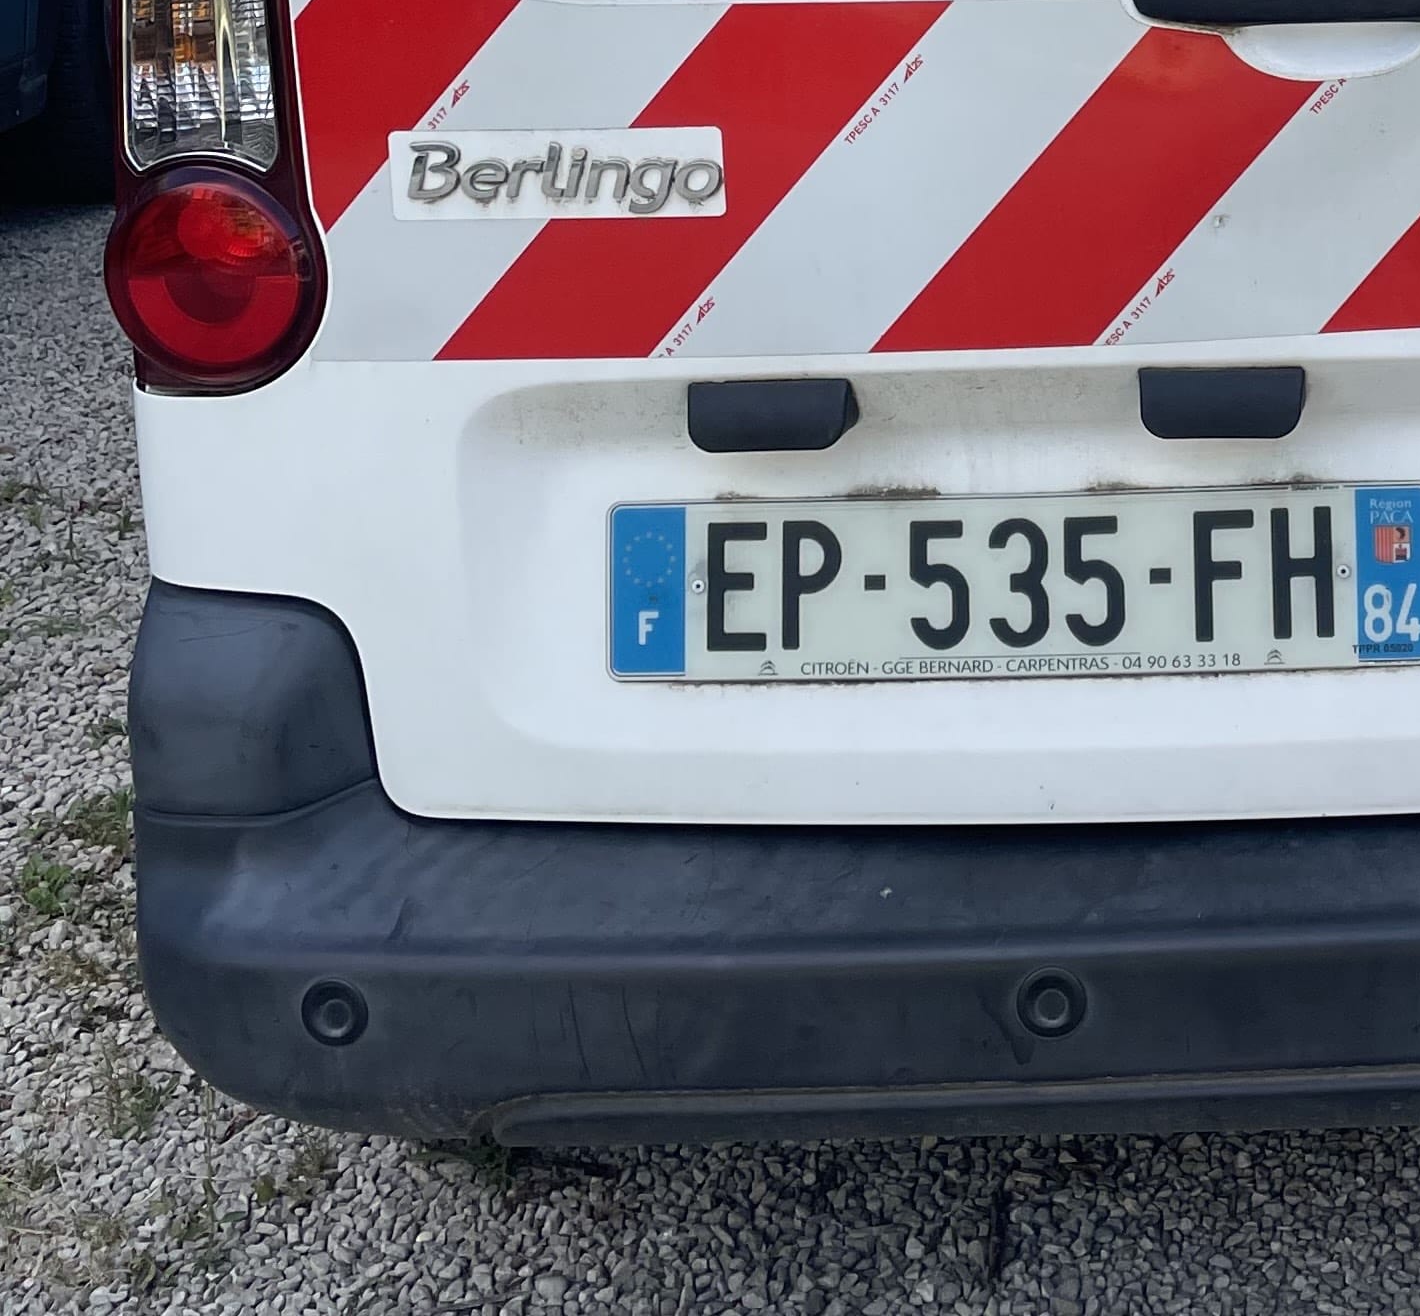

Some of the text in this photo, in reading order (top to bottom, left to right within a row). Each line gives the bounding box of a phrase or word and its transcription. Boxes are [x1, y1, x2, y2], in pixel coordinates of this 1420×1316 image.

[1309, 84, 1339, 114] TPESC
[427, 106, 447, 130] 3117
[844, 114, 873, 144] TPESC
[879, 82, 900, 106] 3117
[407, 140, 724, 214] Berlingo
[1130, 296, 1151, 320] 3117
[673, 323, 693, 346] 3117
[1370, 510, 1415, 525] PACA
[706, 506, 1336, 652] EP-535-FH
[638, 610, 660, 646] F
[800, 658, 870, 676] CITROËN
[881, 659, 914, 675] GGE
[919, 658, 994, 674] BERNARD
[1005, 656, 1110, 672] CARPENTRAS
[1122, 656, 1142, 669] 04
[1148, 655, 1167, 669] 90
[1171, 654, 1192, 668] 63
[1197, 654, 1216, 667] 33
[1222, 653, 1241, 667] 18
